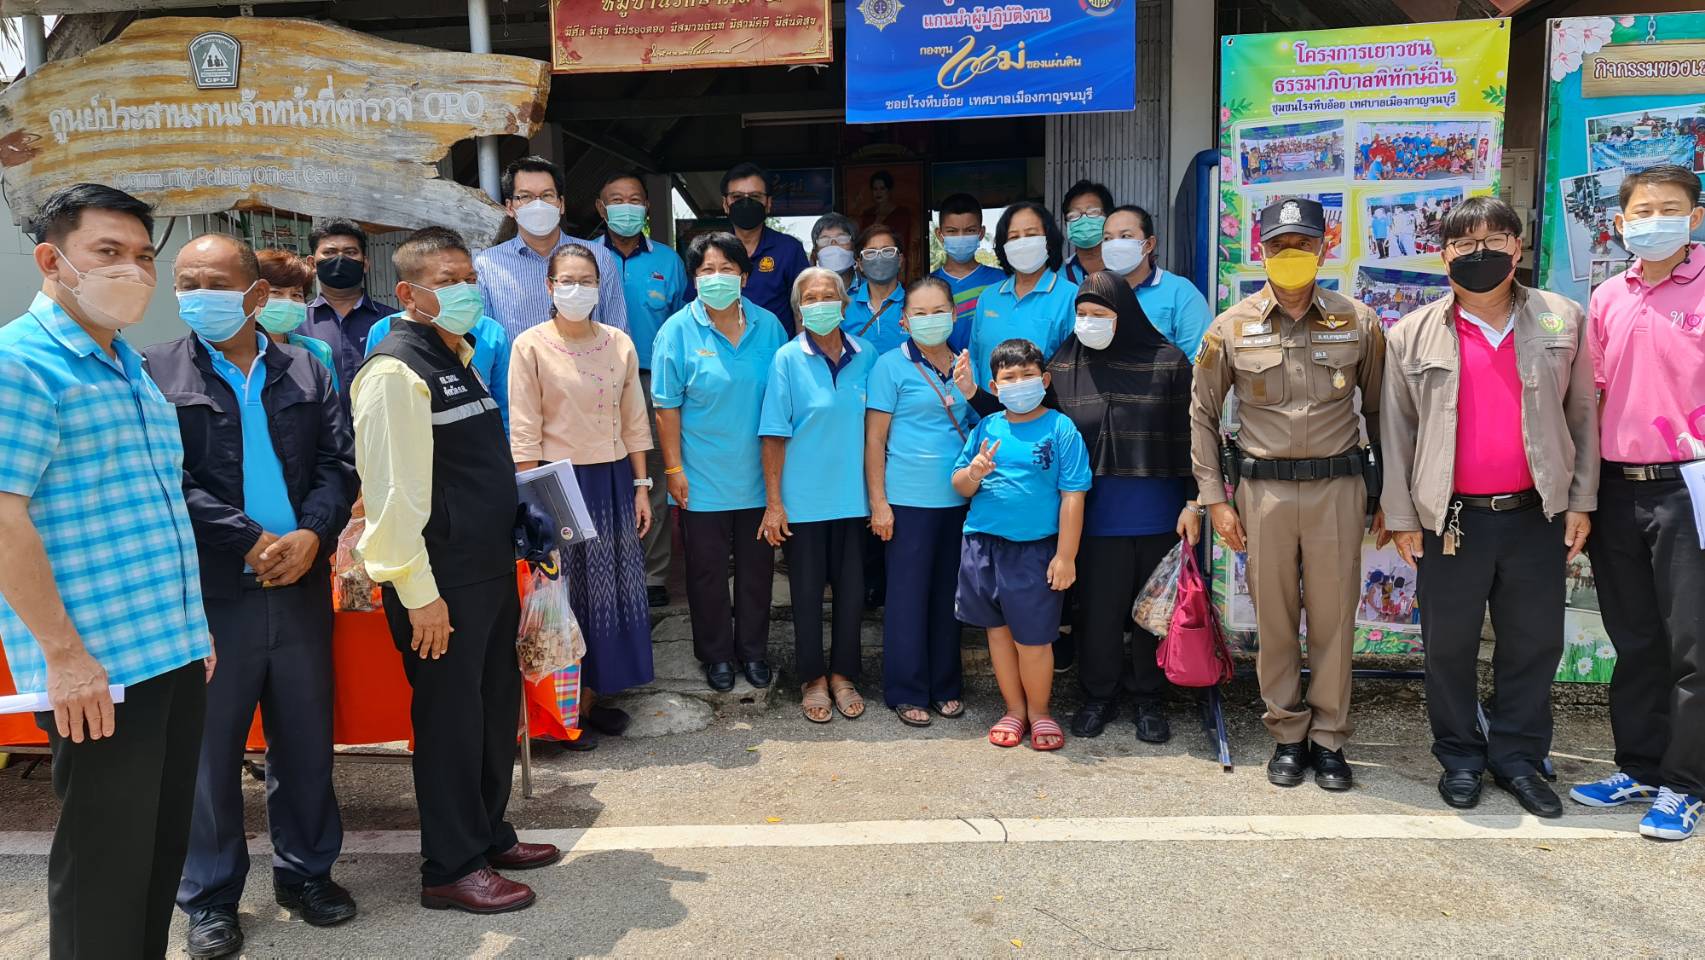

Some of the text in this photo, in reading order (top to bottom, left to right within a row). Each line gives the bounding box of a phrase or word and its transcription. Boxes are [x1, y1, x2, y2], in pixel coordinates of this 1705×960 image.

[922, 6, 1051, 31] แกนนำผู้ปฏิบัติงาน
[920, 45, 953, 58] กองทุน
[1026, 52, 1082, 69] ของแผ่นดิน
[1295, 41, 1433, 64] โครงการเยาวชน
[1274, 61, 1455, 93] ธรรมาภิบาลพิทักษ์ถิ่น
[50, 75, 485, 144] ศูนย์ประสานงานเจ้าหน้าที่ตำรวจ CPO
[885, 87, 1094, 110] ซอยโรงหีบอ้อย เทศบาลเมืองกาญจนบุรี
[1271, 91, 1457, 115] ชุมชนโรงหีบอ้อย เทศบาลเมืองกาญจนบุรี
[197, 166, 251, 191] Policing
